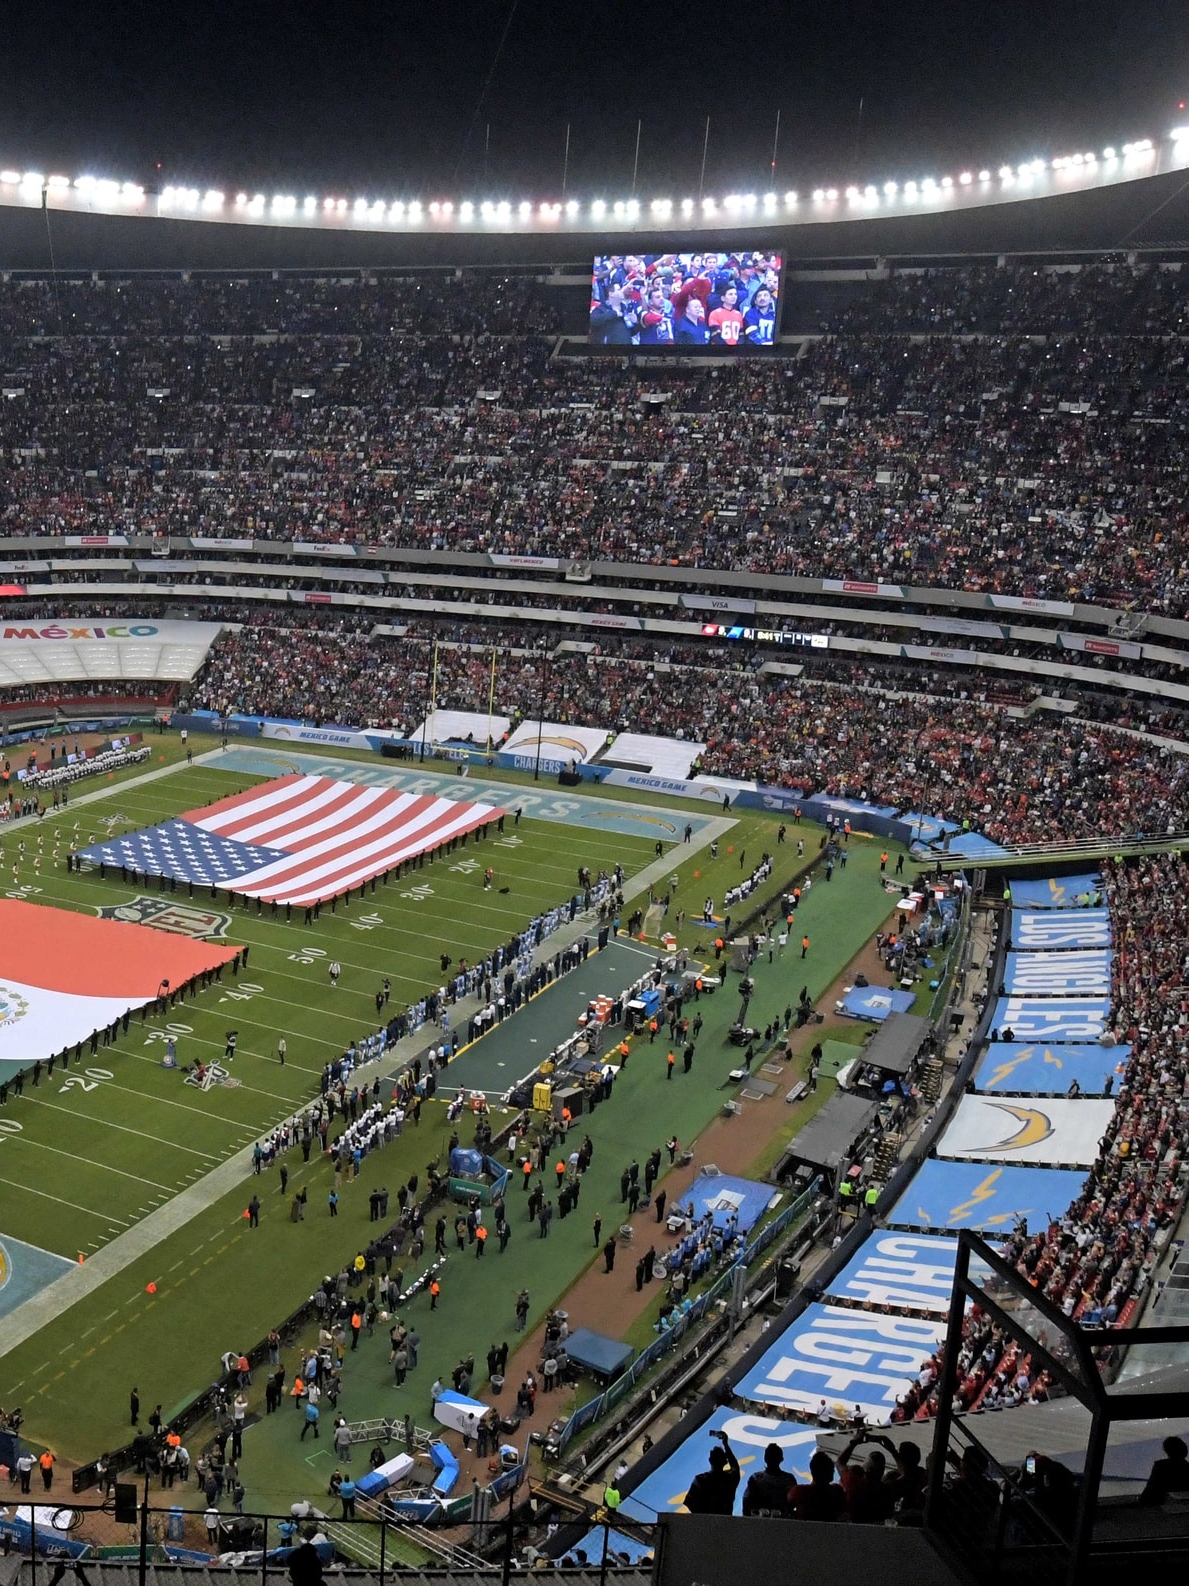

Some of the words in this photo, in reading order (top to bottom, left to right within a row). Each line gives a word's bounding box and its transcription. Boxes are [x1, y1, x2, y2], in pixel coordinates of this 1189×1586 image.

[712, 600, 728, 609] VISA
[299, 731, 328, 742] MEXICO
[328, 734, 351, 744] GAME
[513, 755, 561, 774] CHARGERS
[627, 775, 661, 788] MEXICO
[661, 780, 687, 792] GAME
[493, 836, 524, 848] 10
[449, 861, 481, 874] 20
[400, 885, 435, 901] 30
[350, 914, 384, 931] 40
[1018, 911, 1109, 945] LOS
[287, 947, 327, 964] 50
[223, 982, 265, 1001] 40
[999, 949, 1109, 1036] ANGELES
[148, 1022, 194, 1043] 30
[65, 1067, 114, 1092] 20
